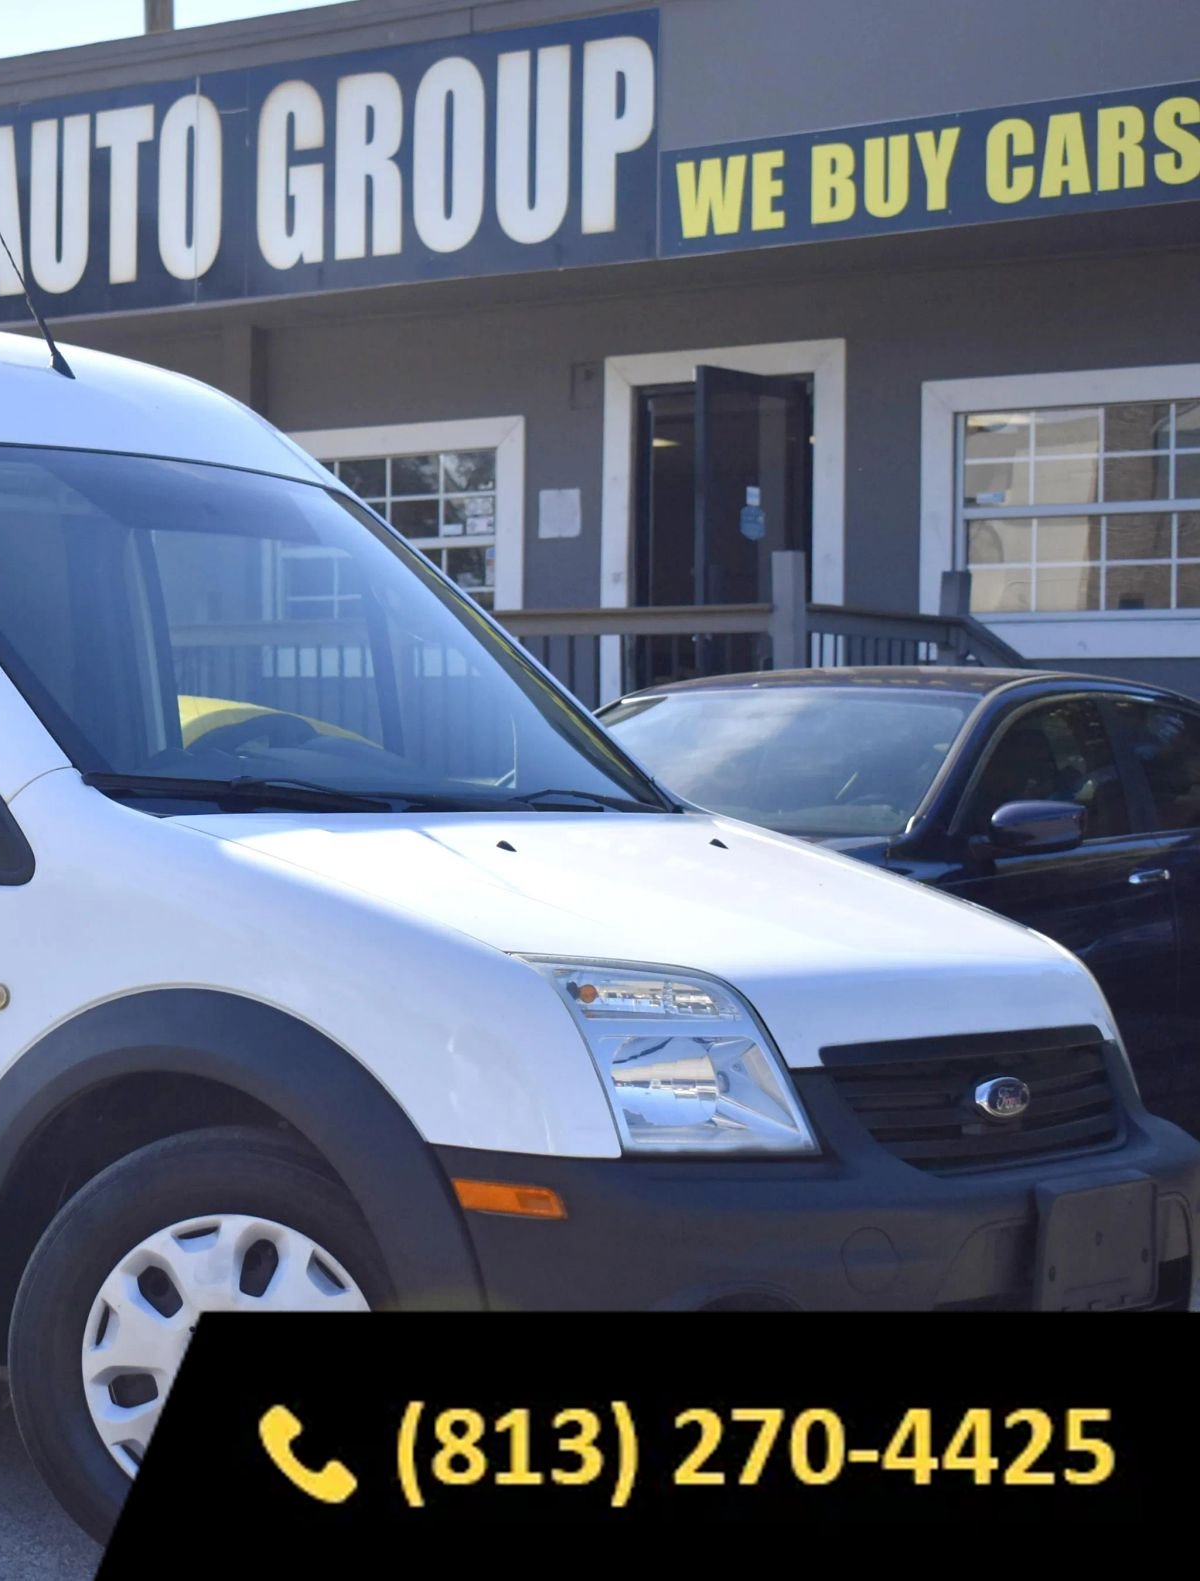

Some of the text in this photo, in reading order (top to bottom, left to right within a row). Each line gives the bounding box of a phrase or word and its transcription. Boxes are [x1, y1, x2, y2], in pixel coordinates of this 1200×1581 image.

[257, 35, 655, 270] GROUP
[675, 97, 1200, 239] WE BUY CARS
